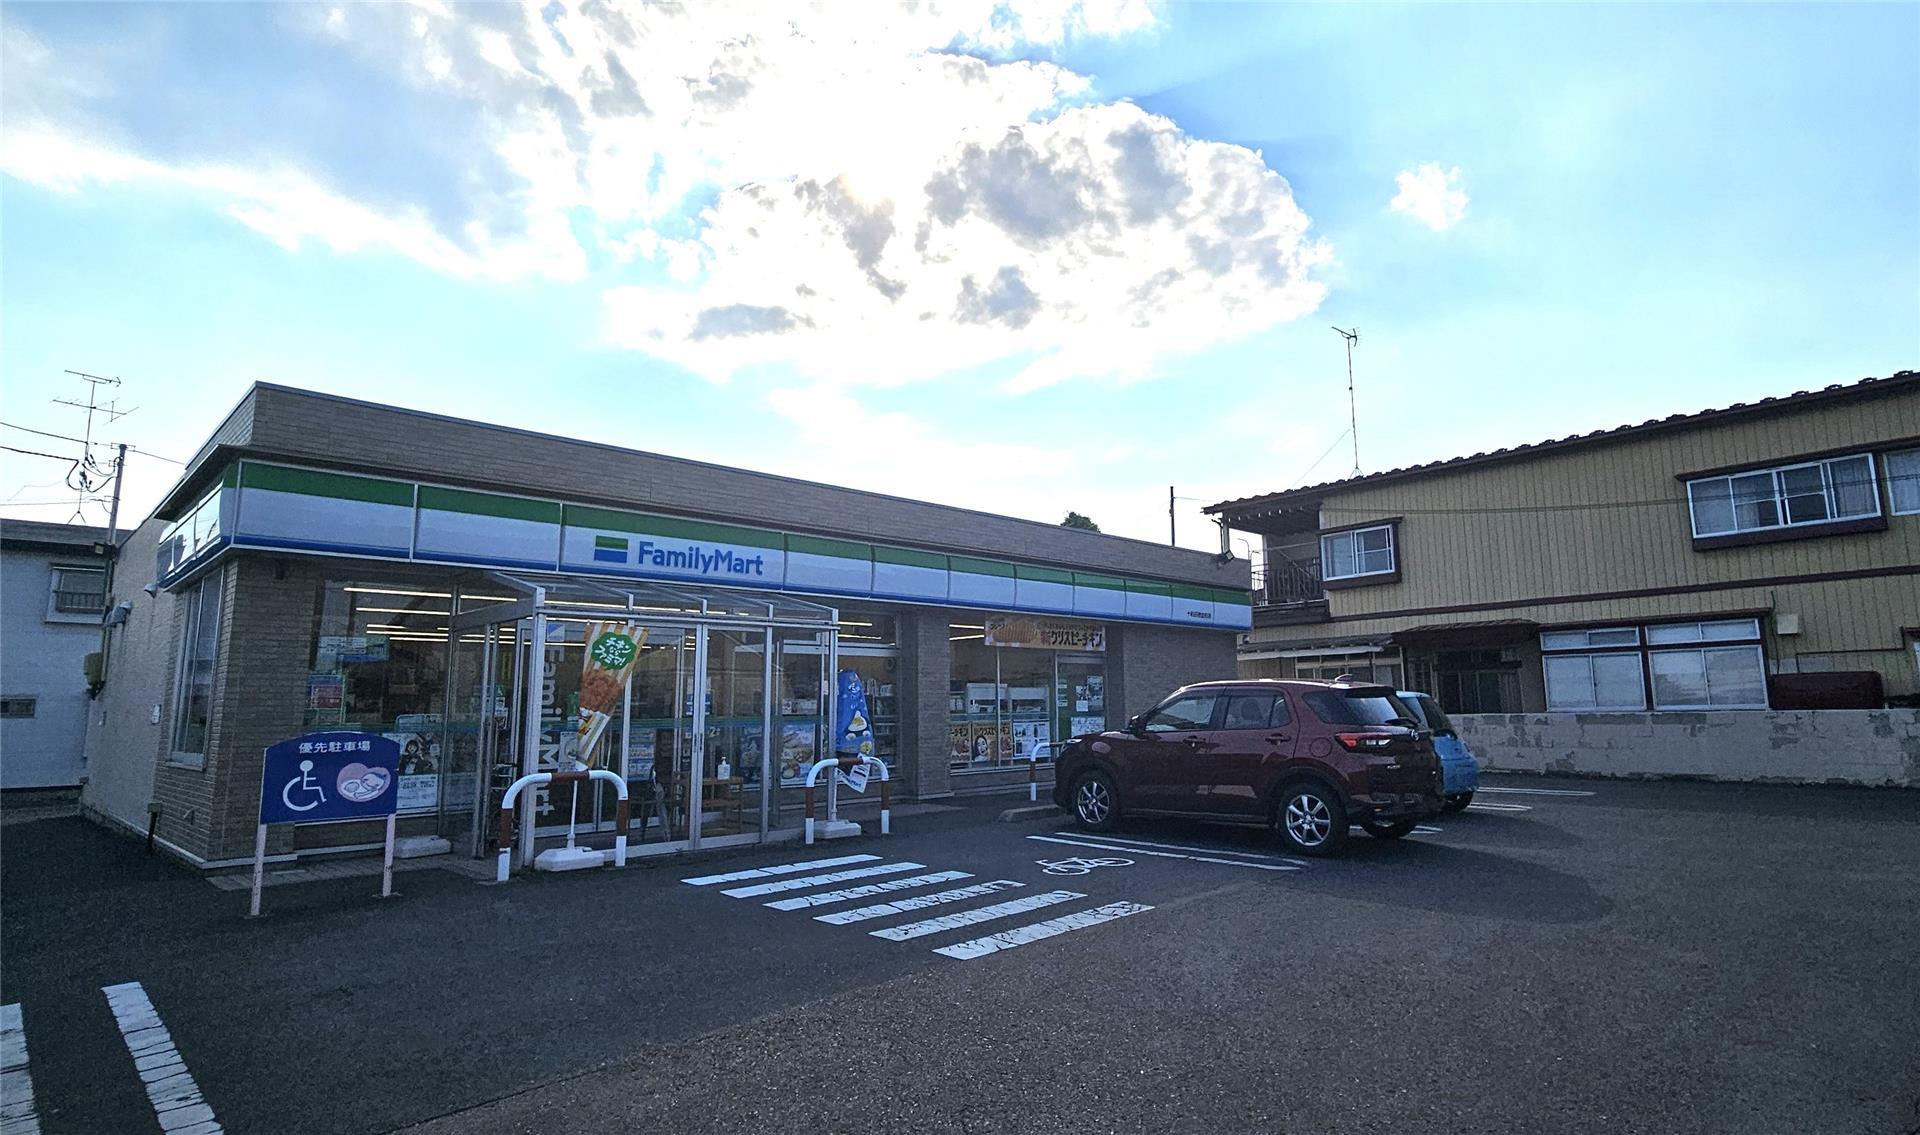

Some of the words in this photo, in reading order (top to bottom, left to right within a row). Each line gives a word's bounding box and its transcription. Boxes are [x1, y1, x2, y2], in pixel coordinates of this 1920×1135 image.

[638, 541, 763, 575] FamilyMart
[605, 637, 632, 654] チキン
[298, 740, 371, 754] 優先駐車場
